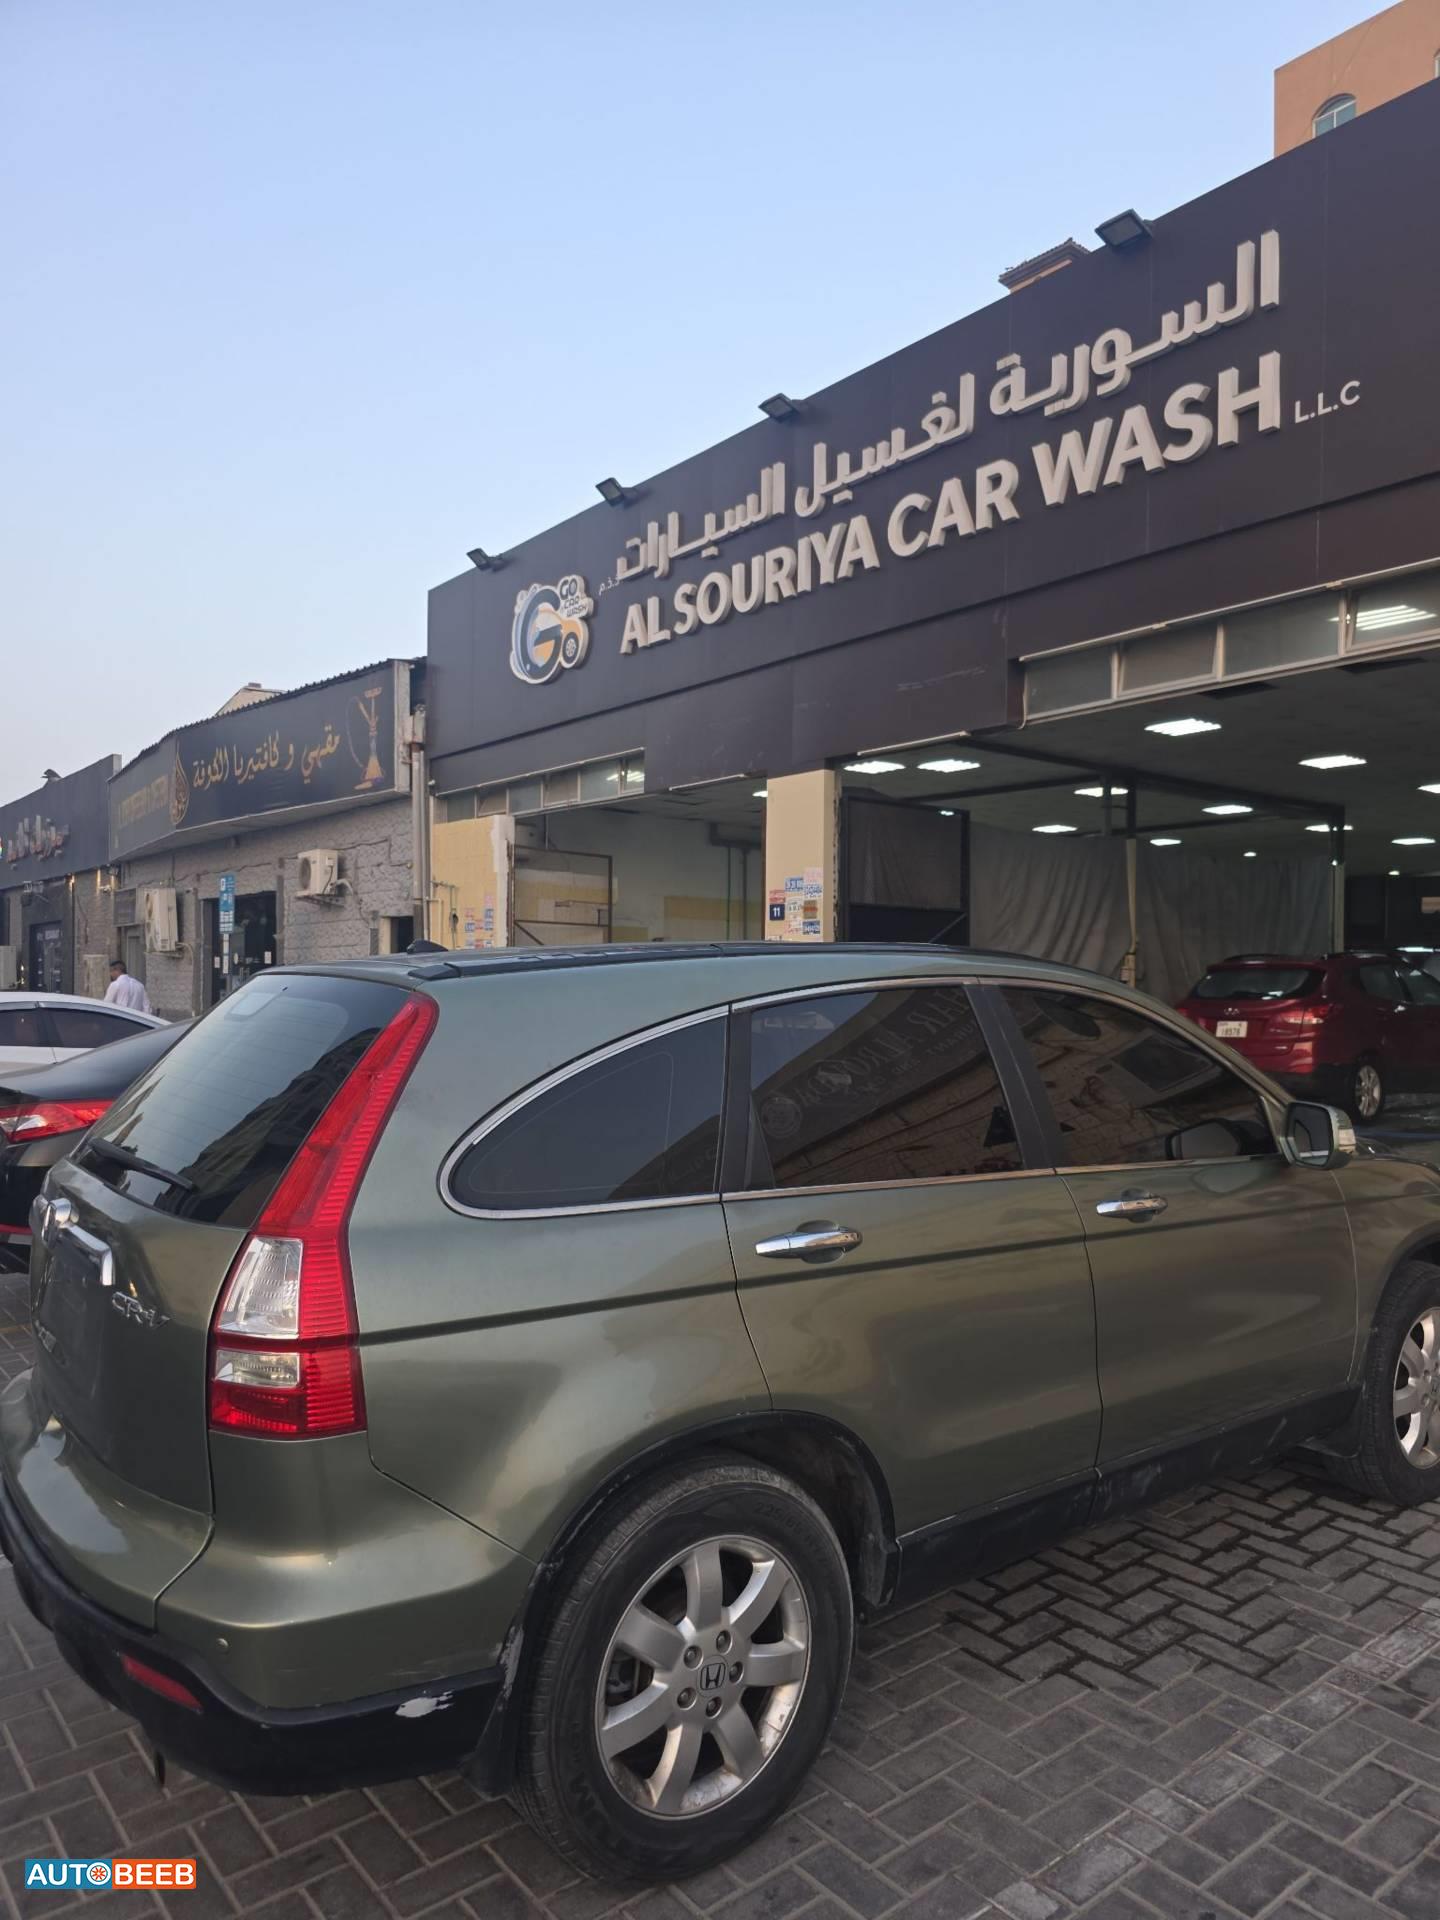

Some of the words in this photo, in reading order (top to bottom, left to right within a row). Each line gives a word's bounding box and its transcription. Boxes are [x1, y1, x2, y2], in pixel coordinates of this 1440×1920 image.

[989, 229, 1280, 417] السورية
[616, 461, 786, 579] السيارات
[795, 372, 975, 518] لغسيل
[887, 458, 1021, 557] CAR
[1031, 350, 1281, 507] WASH
[1294, 380, 1361, 423] L.L.C
